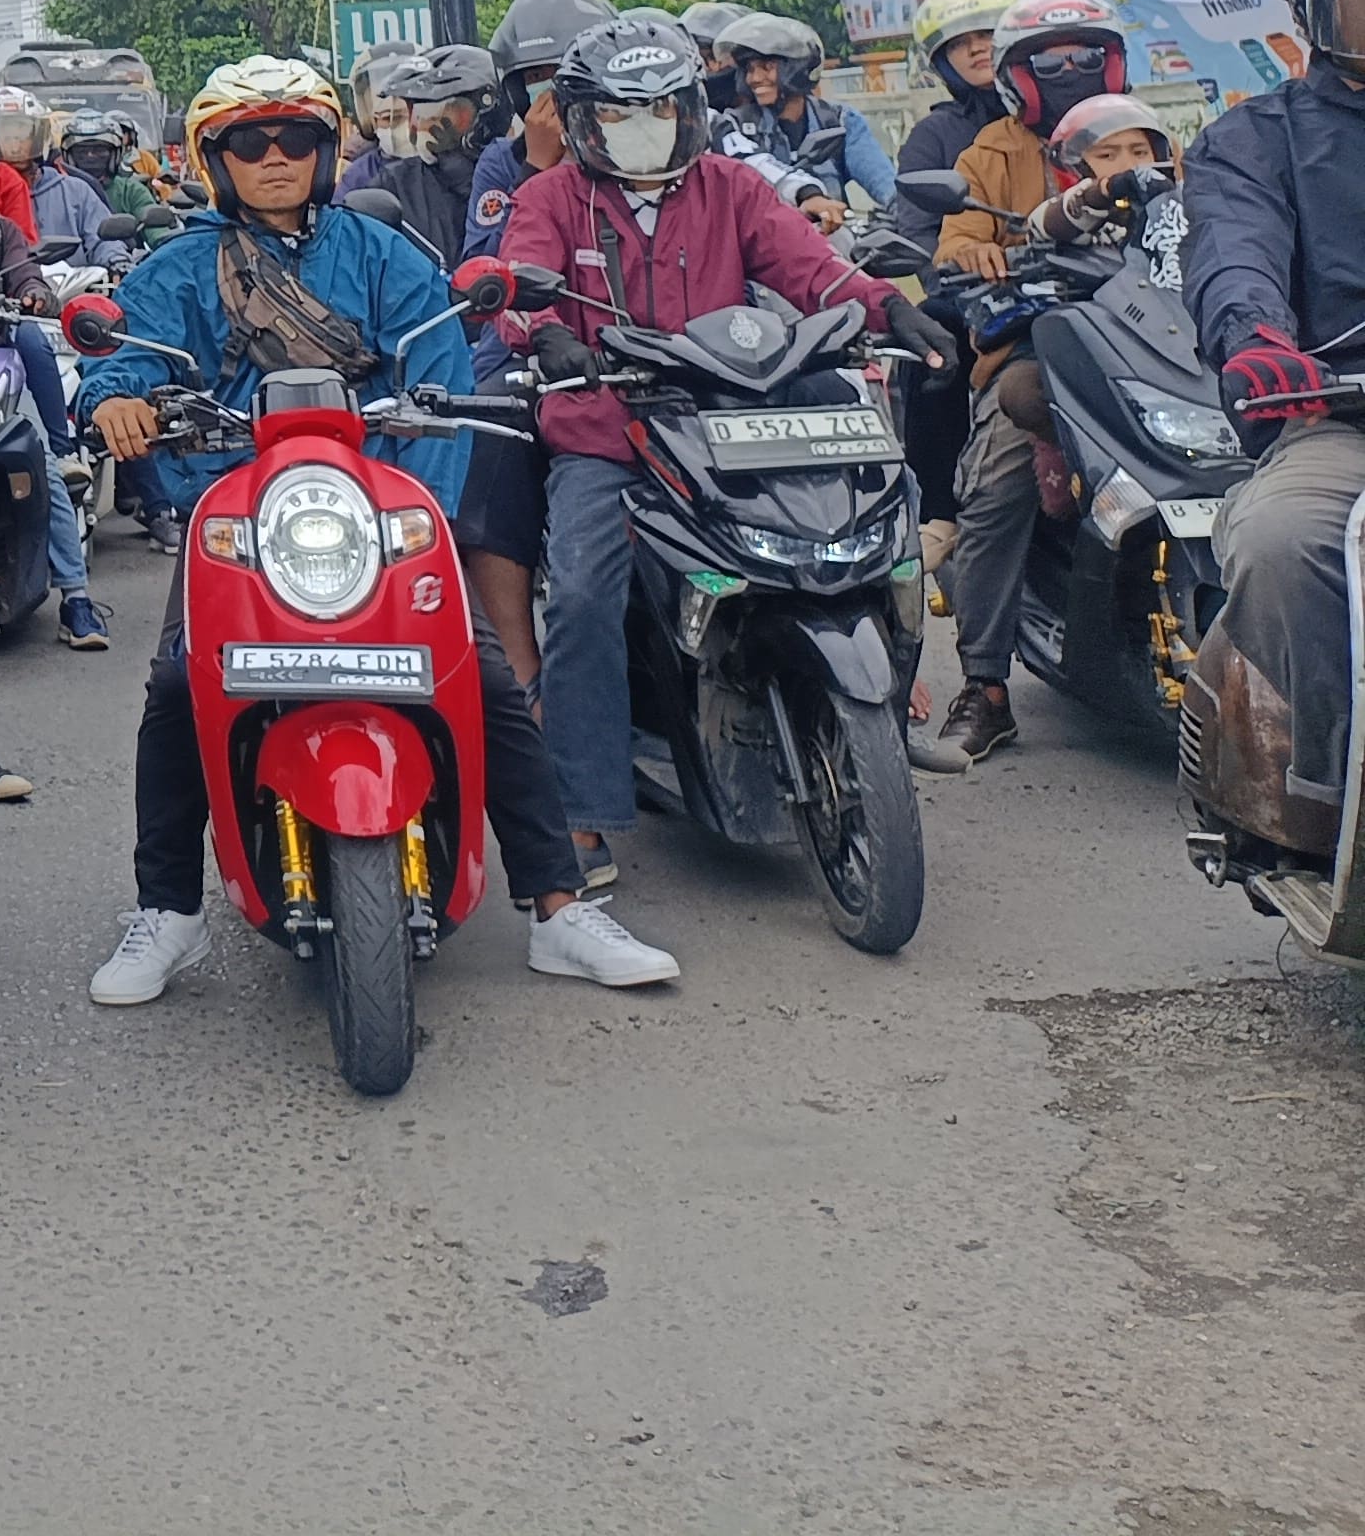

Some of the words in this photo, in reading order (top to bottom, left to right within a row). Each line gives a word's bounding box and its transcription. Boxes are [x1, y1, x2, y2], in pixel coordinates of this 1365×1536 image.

[619, 51, 662, 68] NHK
[715, 422, 731, 440] D
[746, 418, 810, 439] 5521
[826, 415, 876, 436] ZCF
[243, 653, 258, 669] F
[270, 653, 341, 669] 5784
[357, 654, 412, 672] FDM
